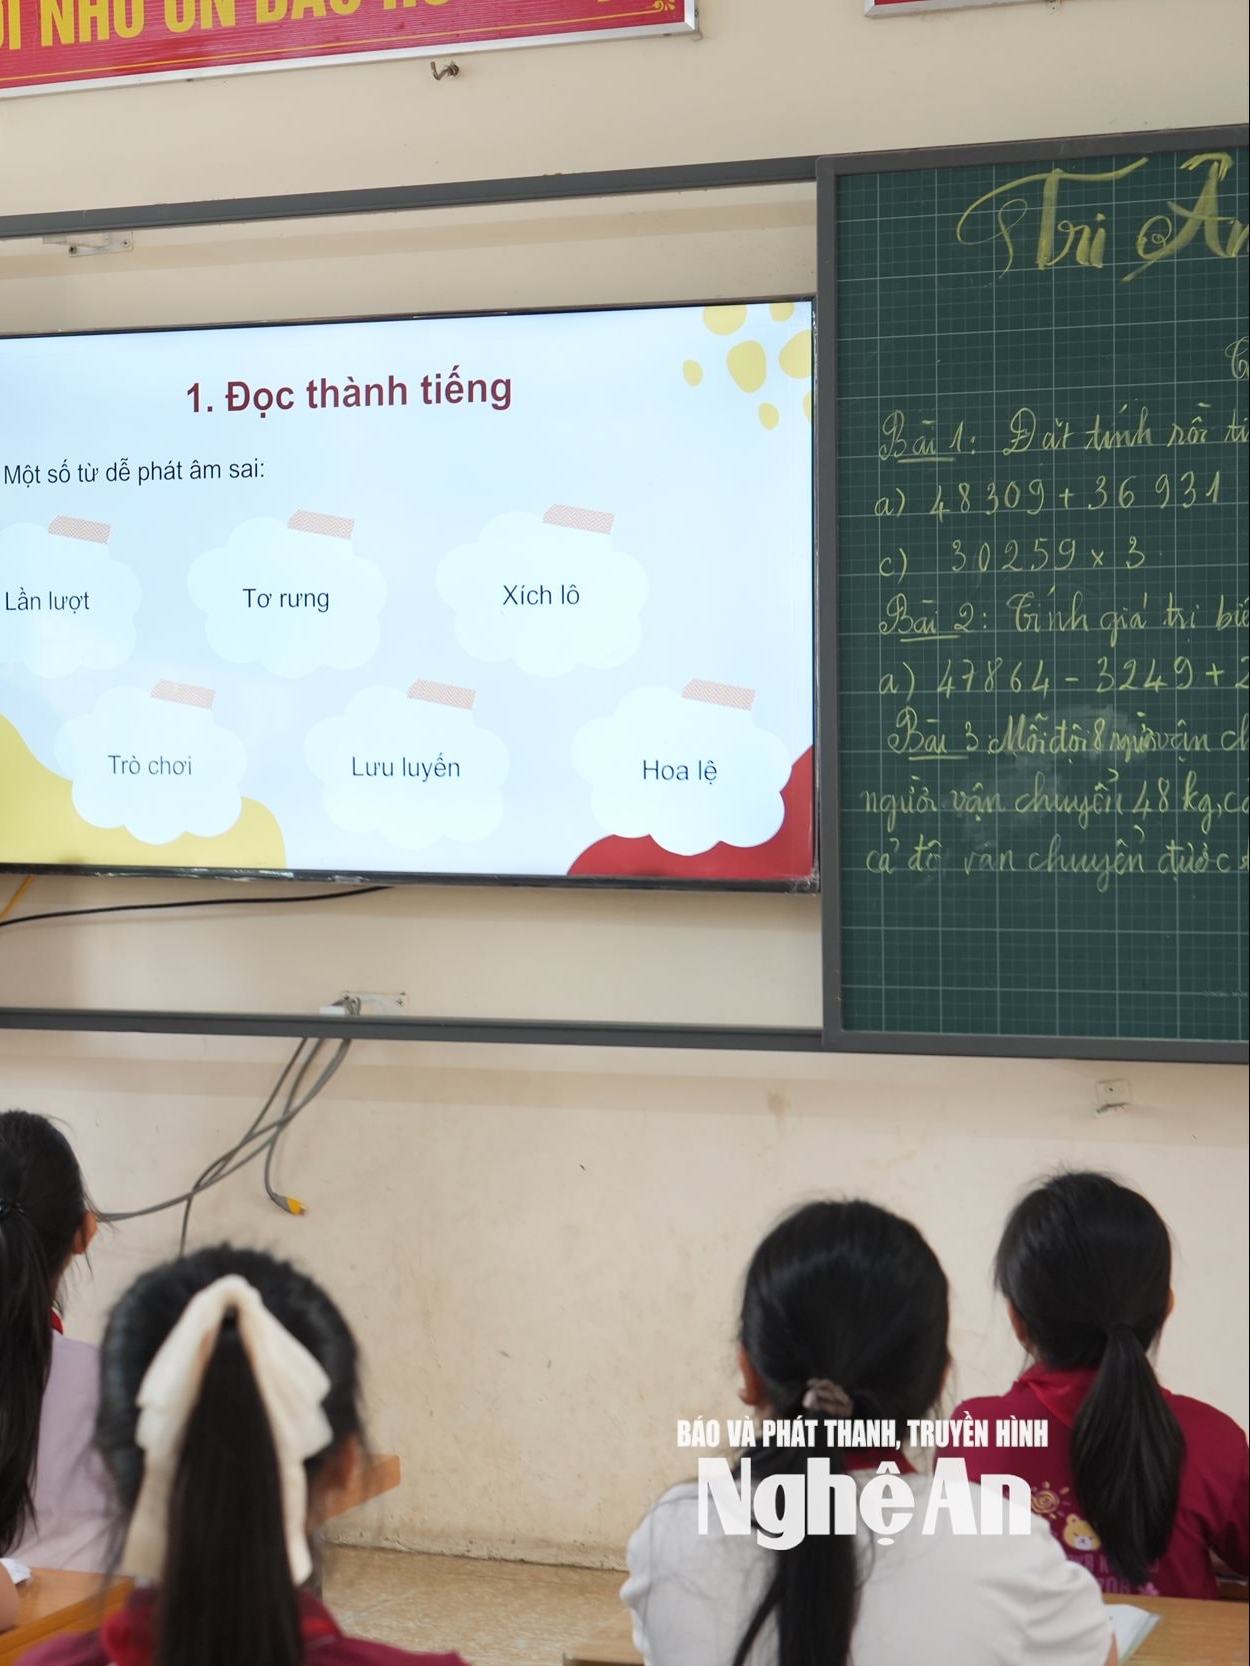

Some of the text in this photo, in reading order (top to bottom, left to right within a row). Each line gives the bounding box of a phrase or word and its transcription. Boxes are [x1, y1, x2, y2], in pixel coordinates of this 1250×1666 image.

[187, 365, 511, 418] 1. Đọc thành tiếng
[879, 410, 937, 461] Bài
[1003, 407, 1075, 456] Đặt
[1085, 403, 1153, 451] tính
[1167, 402, 1212, 447] rồi
[4, 458, 265, 488] Một số từ dễ phát âm sai:
[874, 488, 906, 518] a)
[879, 548, 907, 584] c)
[5, 587, 90, 614] Lần lượt
[242, 588, 330, 613] Tơ rưng
[502, 584, 580, 605] Xích lô
[879, 592, 938, 635] Bài
[1006, 585, 1089, 632] Tính
[1100, 592, 1148, 647] giá
[879, 661, 914, 702] a)
[888, 706, 948, 754] Bài
[108, 755, 192, 776] Trò chơi
[351, 752, 461, 783] Lưu luyến
[642, 759, 718, 785] Hoa lệ
[861, 775, 937, 832] người
[950, 782, 1005, 822] vận
[1015, 768, 1124, 830] chuyển
[1132, 777, 1170, 822] 48
[866, 837, 899, 874] cả
[1028, 824, 1147, 893] chuyển
[1158, 839, 1230, 882] được
